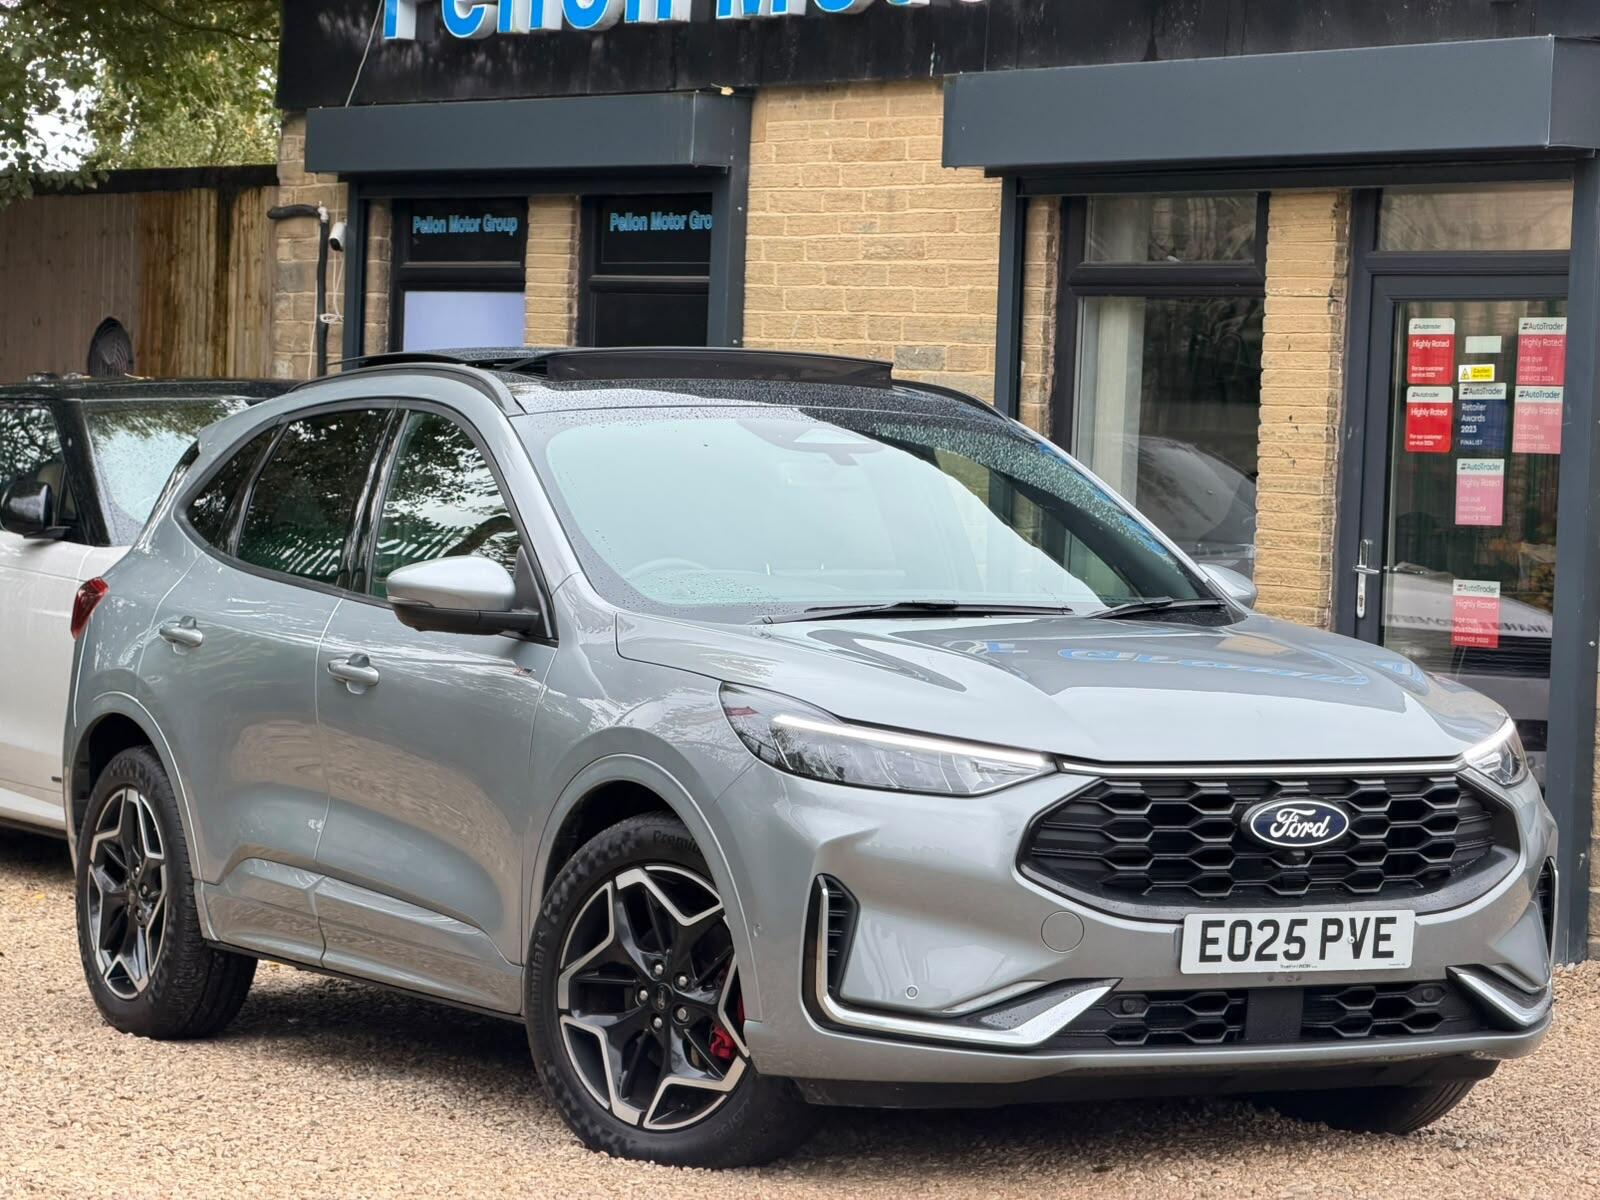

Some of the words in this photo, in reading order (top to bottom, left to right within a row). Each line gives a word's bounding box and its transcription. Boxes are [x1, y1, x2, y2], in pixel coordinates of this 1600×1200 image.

[412, 215, 447, 234] Pellon
[448, 214, 481, 233] Motor
[483, 213, 518, 236] Group
[609, 212, 648, 232] Pellon
[650, 211, 687, 230] Motor
[1412, 339, 1431, 350] Highly
[1432, 339, 1449, 348] Rated
[1521, 338, 1541, 348] Highly
[1542, 337, 1563, 347] Rated
[1525, 390, 1560, 398] AutoTrader
[1461, 402, 1487, 411] Retailer
[1410, 407, 1429, 418] Highly
[1430, 407, 1448, 416] Rated
[1461, 414, 1486, 422] Awards
[1460, 425, 1477, 433] 2023
[1270, 808, 1331, 838] Ford
[1198, 918, 1308, 963] EO25
[1319, 916, 1397, 961] PVE
